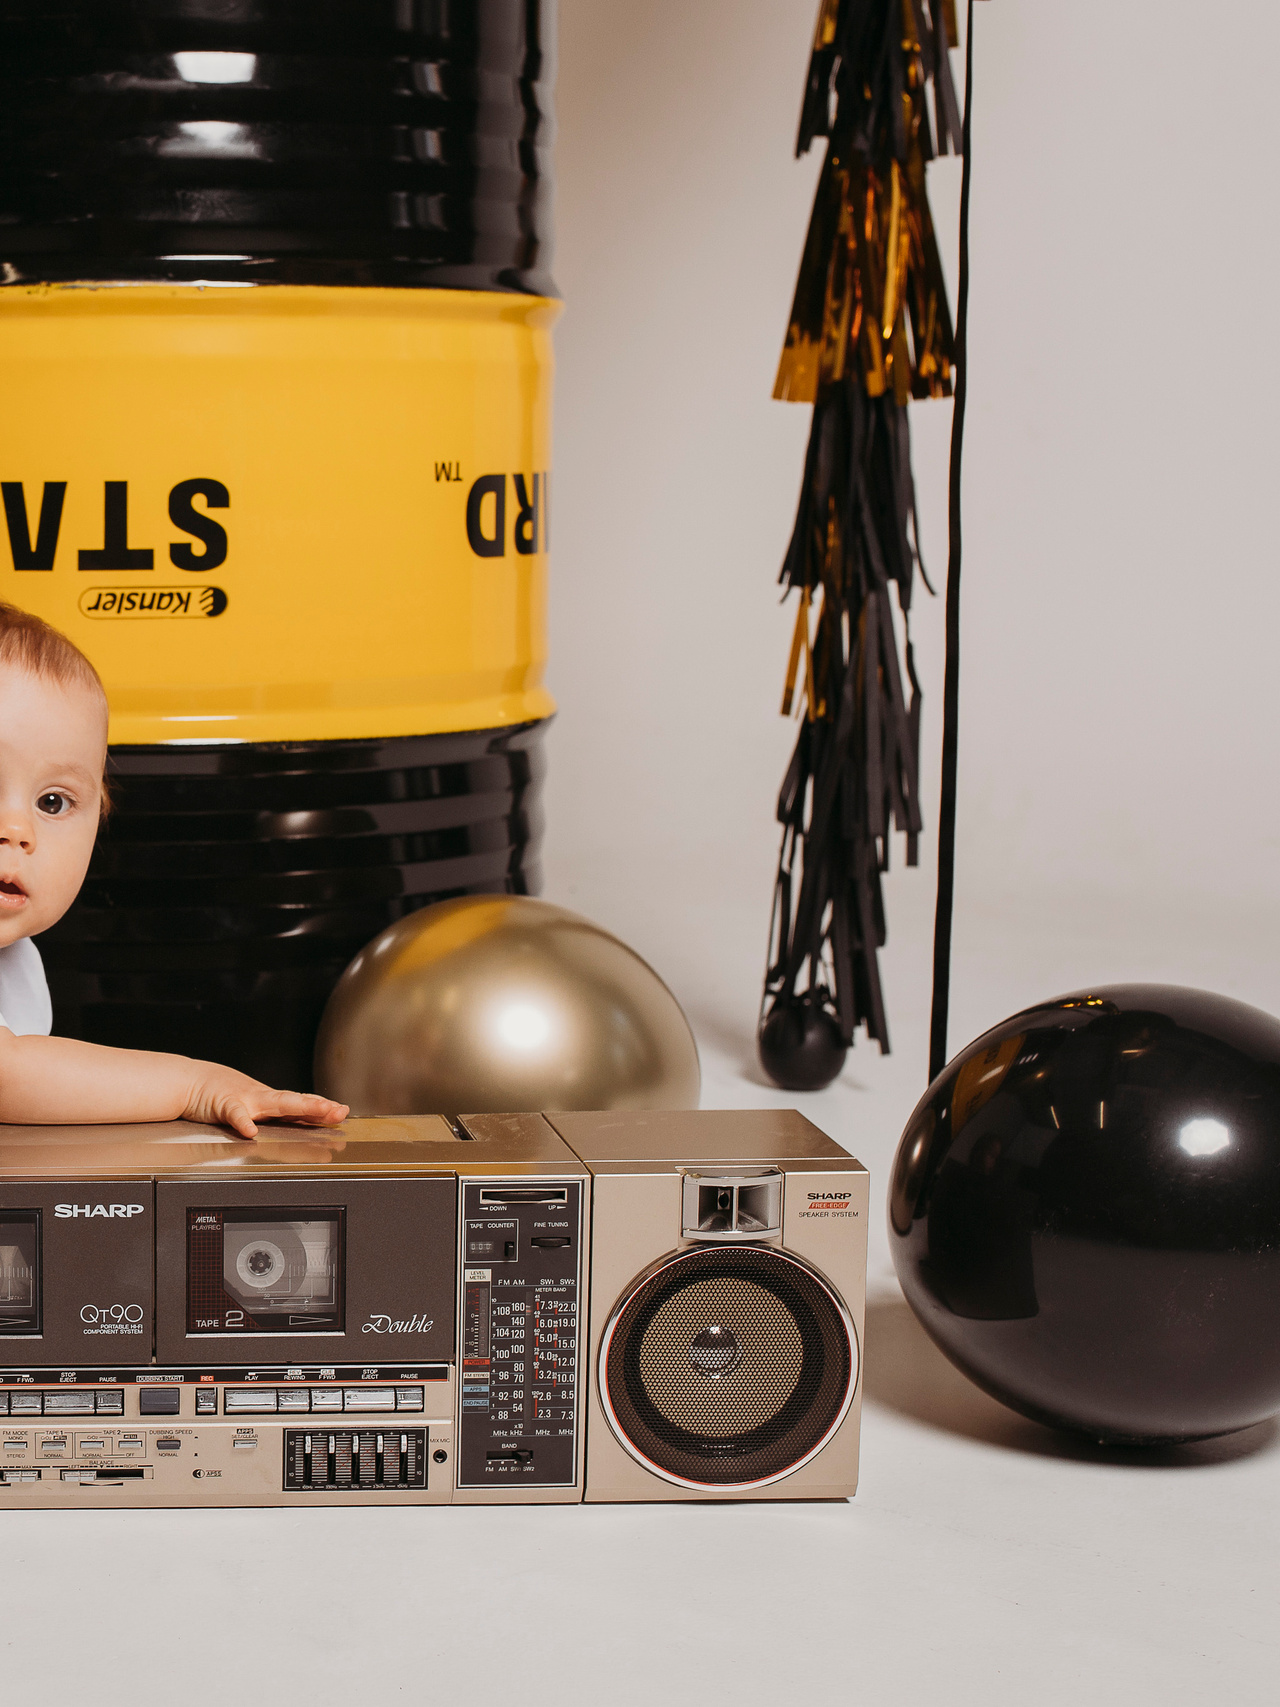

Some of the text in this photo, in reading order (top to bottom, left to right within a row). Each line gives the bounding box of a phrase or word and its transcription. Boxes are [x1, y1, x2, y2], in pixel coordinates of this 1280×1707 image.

[435, 462, 548, 558] RD TM
[88, 592, 192, 614] Kansler
[54, 1204, 144, 1218] SHARP
[512, 1302, 525, 1312] 160
[540, 1301, 553, 1310] 7.3
[558, 1303, 576, 1312] 22.0
[80, 1304, 144, 1323] QT90
[497, 1306, 510, 1315] 108
[225, 1310, 244, 1327] 2
[511, 1317, 525, 1325] 140
[558, 1318, 576, 1327] 19.0
[361, 1314, 434, 1334] Double
[540, 1319, 552, 1328] 6.0
[496, 1328, 509, 1337] 104
[511, 1330, 525, 1338] 120
[540, 1334, 552, 1342] 5.0
[558, 1339, 575, 1348] 15.0
[511, 1344, 525, 1354] 100
[496, 1350, 509, 1358] 100
[539, 1352, 552, 1360] 4.0
[558, 1357, 575, 1366] 12.0
[514, 1362, 524, 1372] 80
[498, 1371, 509, 1380] 96
[514, 1374, 524, 1383] 70
[539, 1370, 551, 1379] 3.2
[558, 1374, 574, 1382] 10.0
[498, 1392, 508, 1400] 92
[513, 1390, 524, 1399] 60
[539, 1392, 551, 1400] 2.6
[561, 1390, 574, 1399] 8.5
[513, 1403, 523, 1412] 54
[498, 1411, 508, 1420] 88
[538, 1409, 551, 1418] 2.3
[561, 1411, 573, 1420] 7.3
